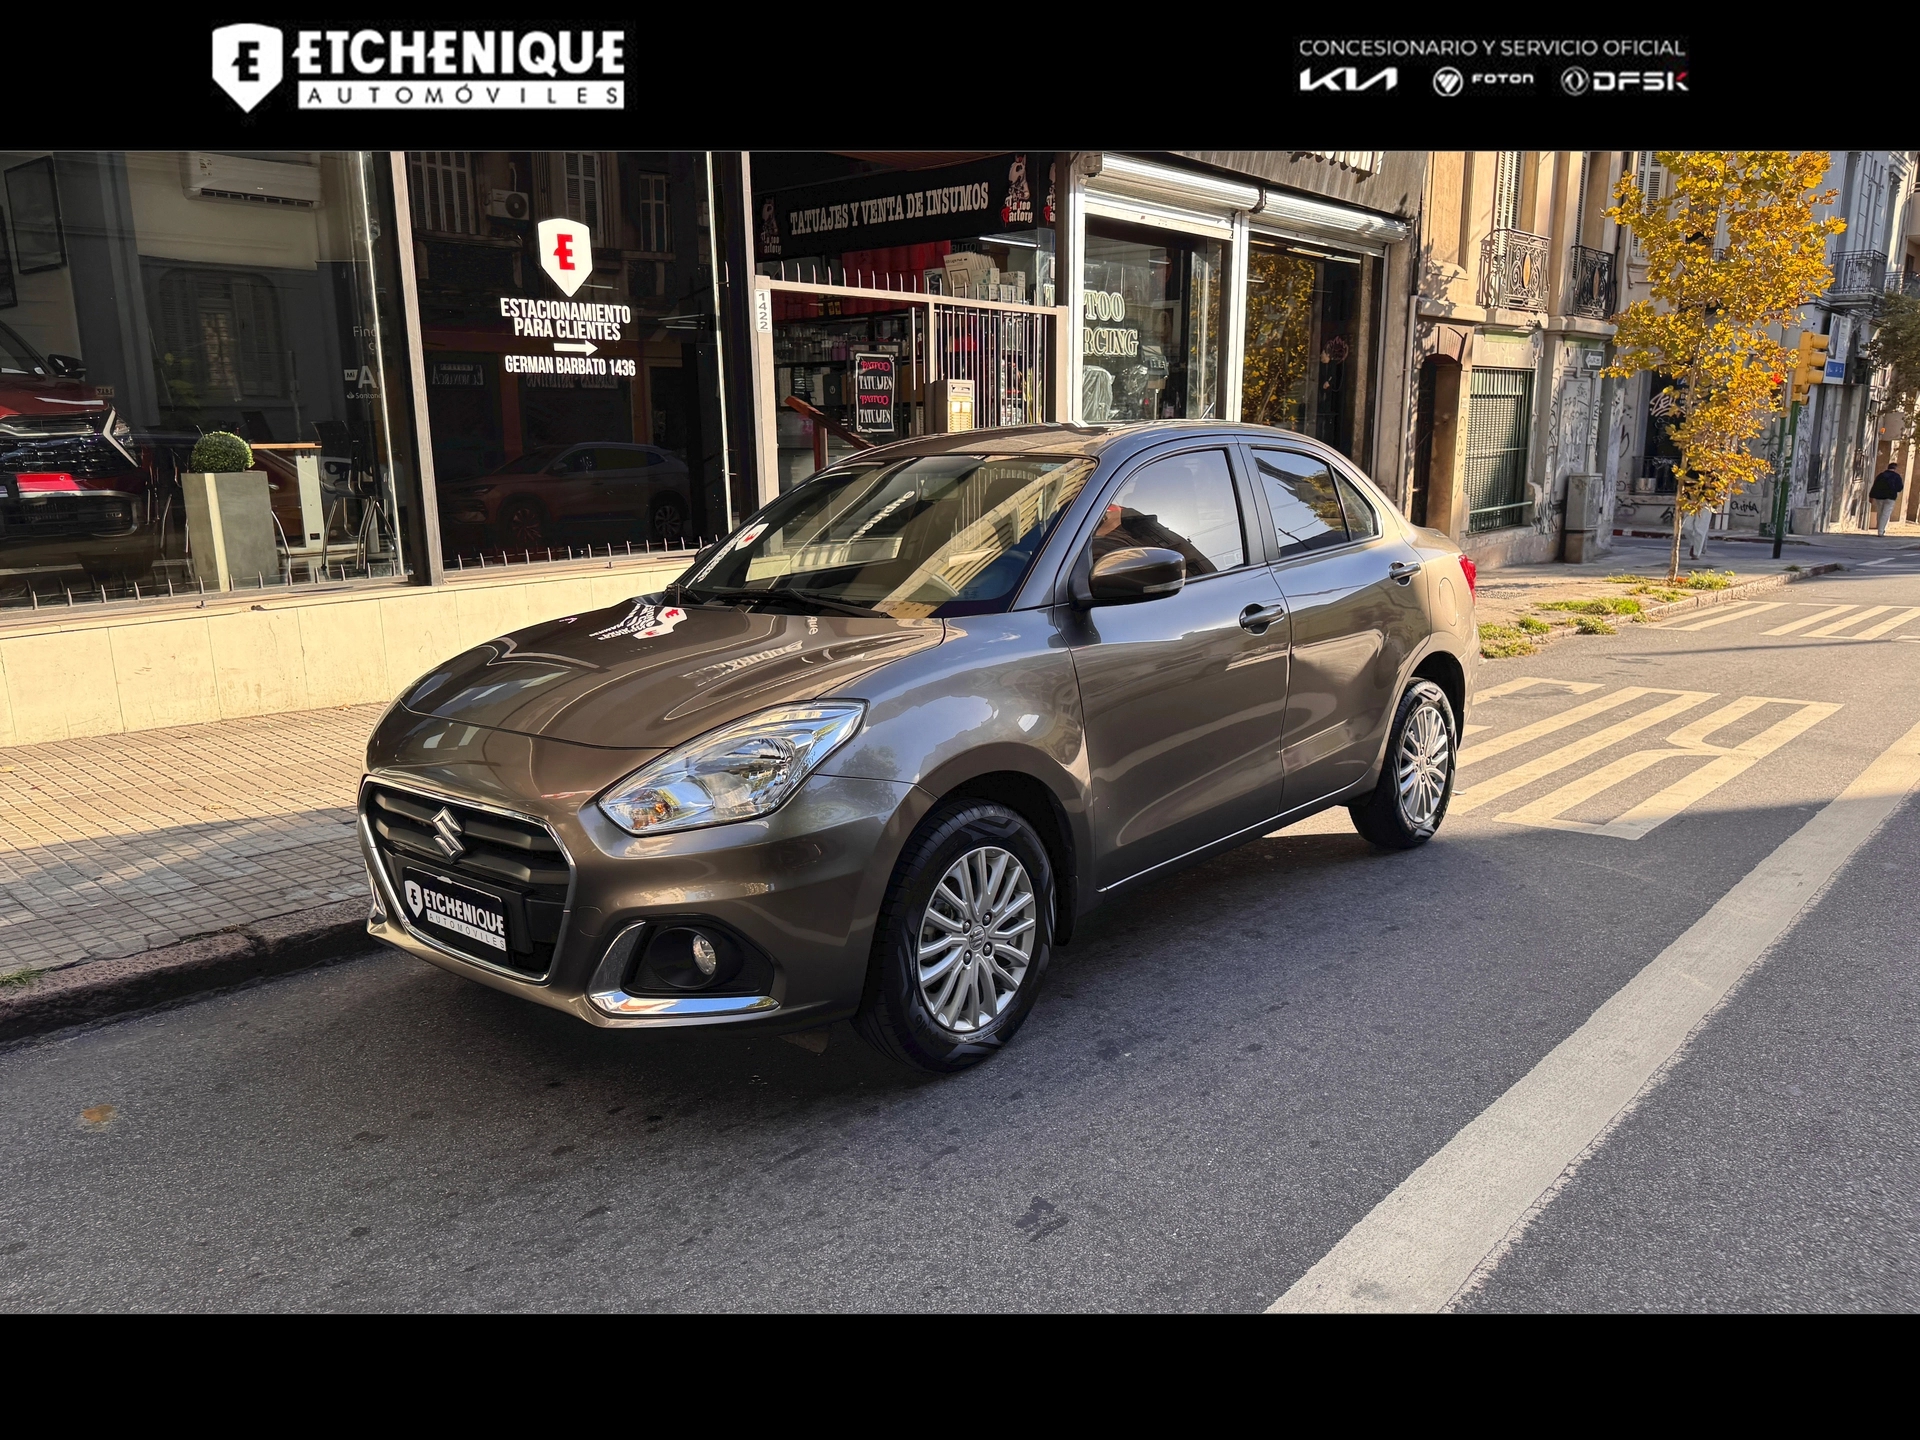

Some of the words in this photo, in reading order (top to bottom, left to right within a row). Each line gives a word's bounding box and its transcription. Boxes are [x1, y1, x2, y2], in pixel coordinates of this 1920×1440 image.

[790, 203, 849, 236] TATUAJES
[850, 202, 859, 227] Y
[860, 194, 905, 225] VENTA
[906, 191, 924, 219] DE
[925, 181, 990, 216] INSUMOS
[500, 297, 632, 324] ESTACIONAMIENTO
[758, 292, 769, 330] 1422
[514, 318, 554, 337] PARA
[556, 320, 622, 341] CLIENTES
[504, 355, 554, 374] GERMAN
[556, 358, 607, 375] BARBATO
[609, 359, 636, 377] 1436
[859, 375, 893, 390] TATUAJES
[859, 408, 891, 423] TATUAJES
[423, 888, 505, 936] ETCHENIQUE
